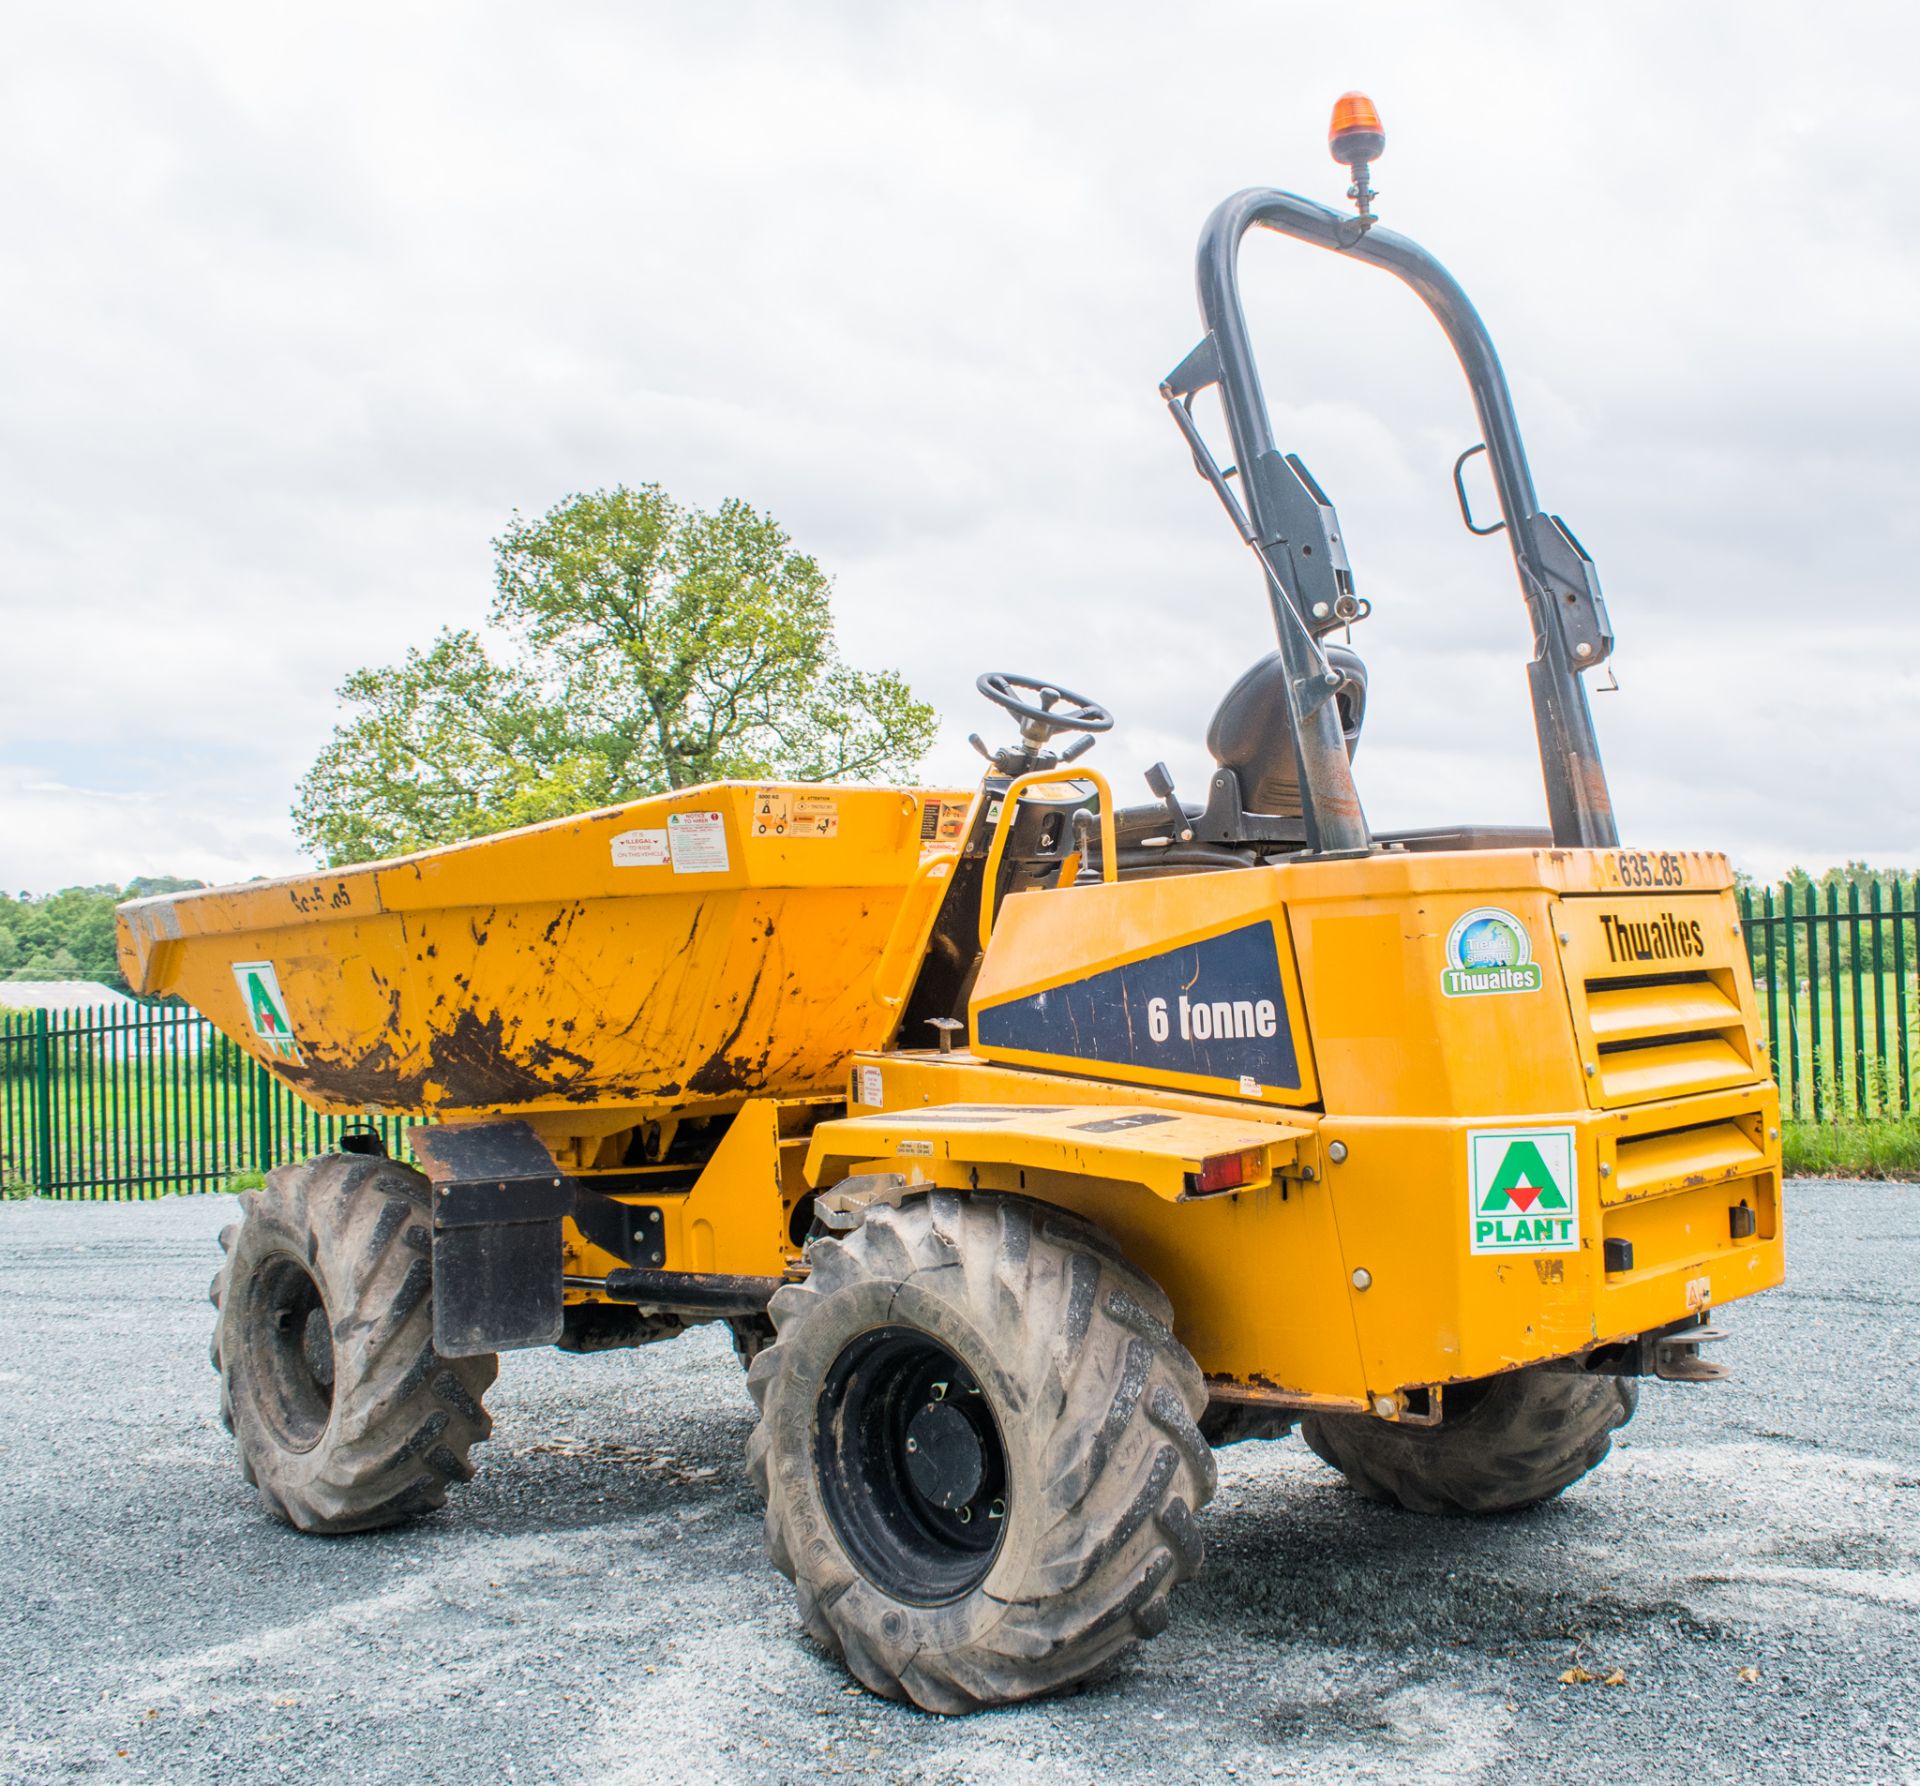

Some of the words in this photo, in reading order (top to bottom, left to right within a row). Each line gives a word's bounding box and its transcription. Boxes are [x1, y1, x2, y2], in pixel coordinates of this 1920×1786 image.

[1599, 913, 1704, 962] Thwaites
[1449, 968, 1535, 992] Thwaites
[1148, 997, 1169, 1042] 6
[1179, 995, 1277, 1040] tonne
[1481, 1141, 1568, 1211] A
[1476, 1218, 1573, 1243] PLANT
